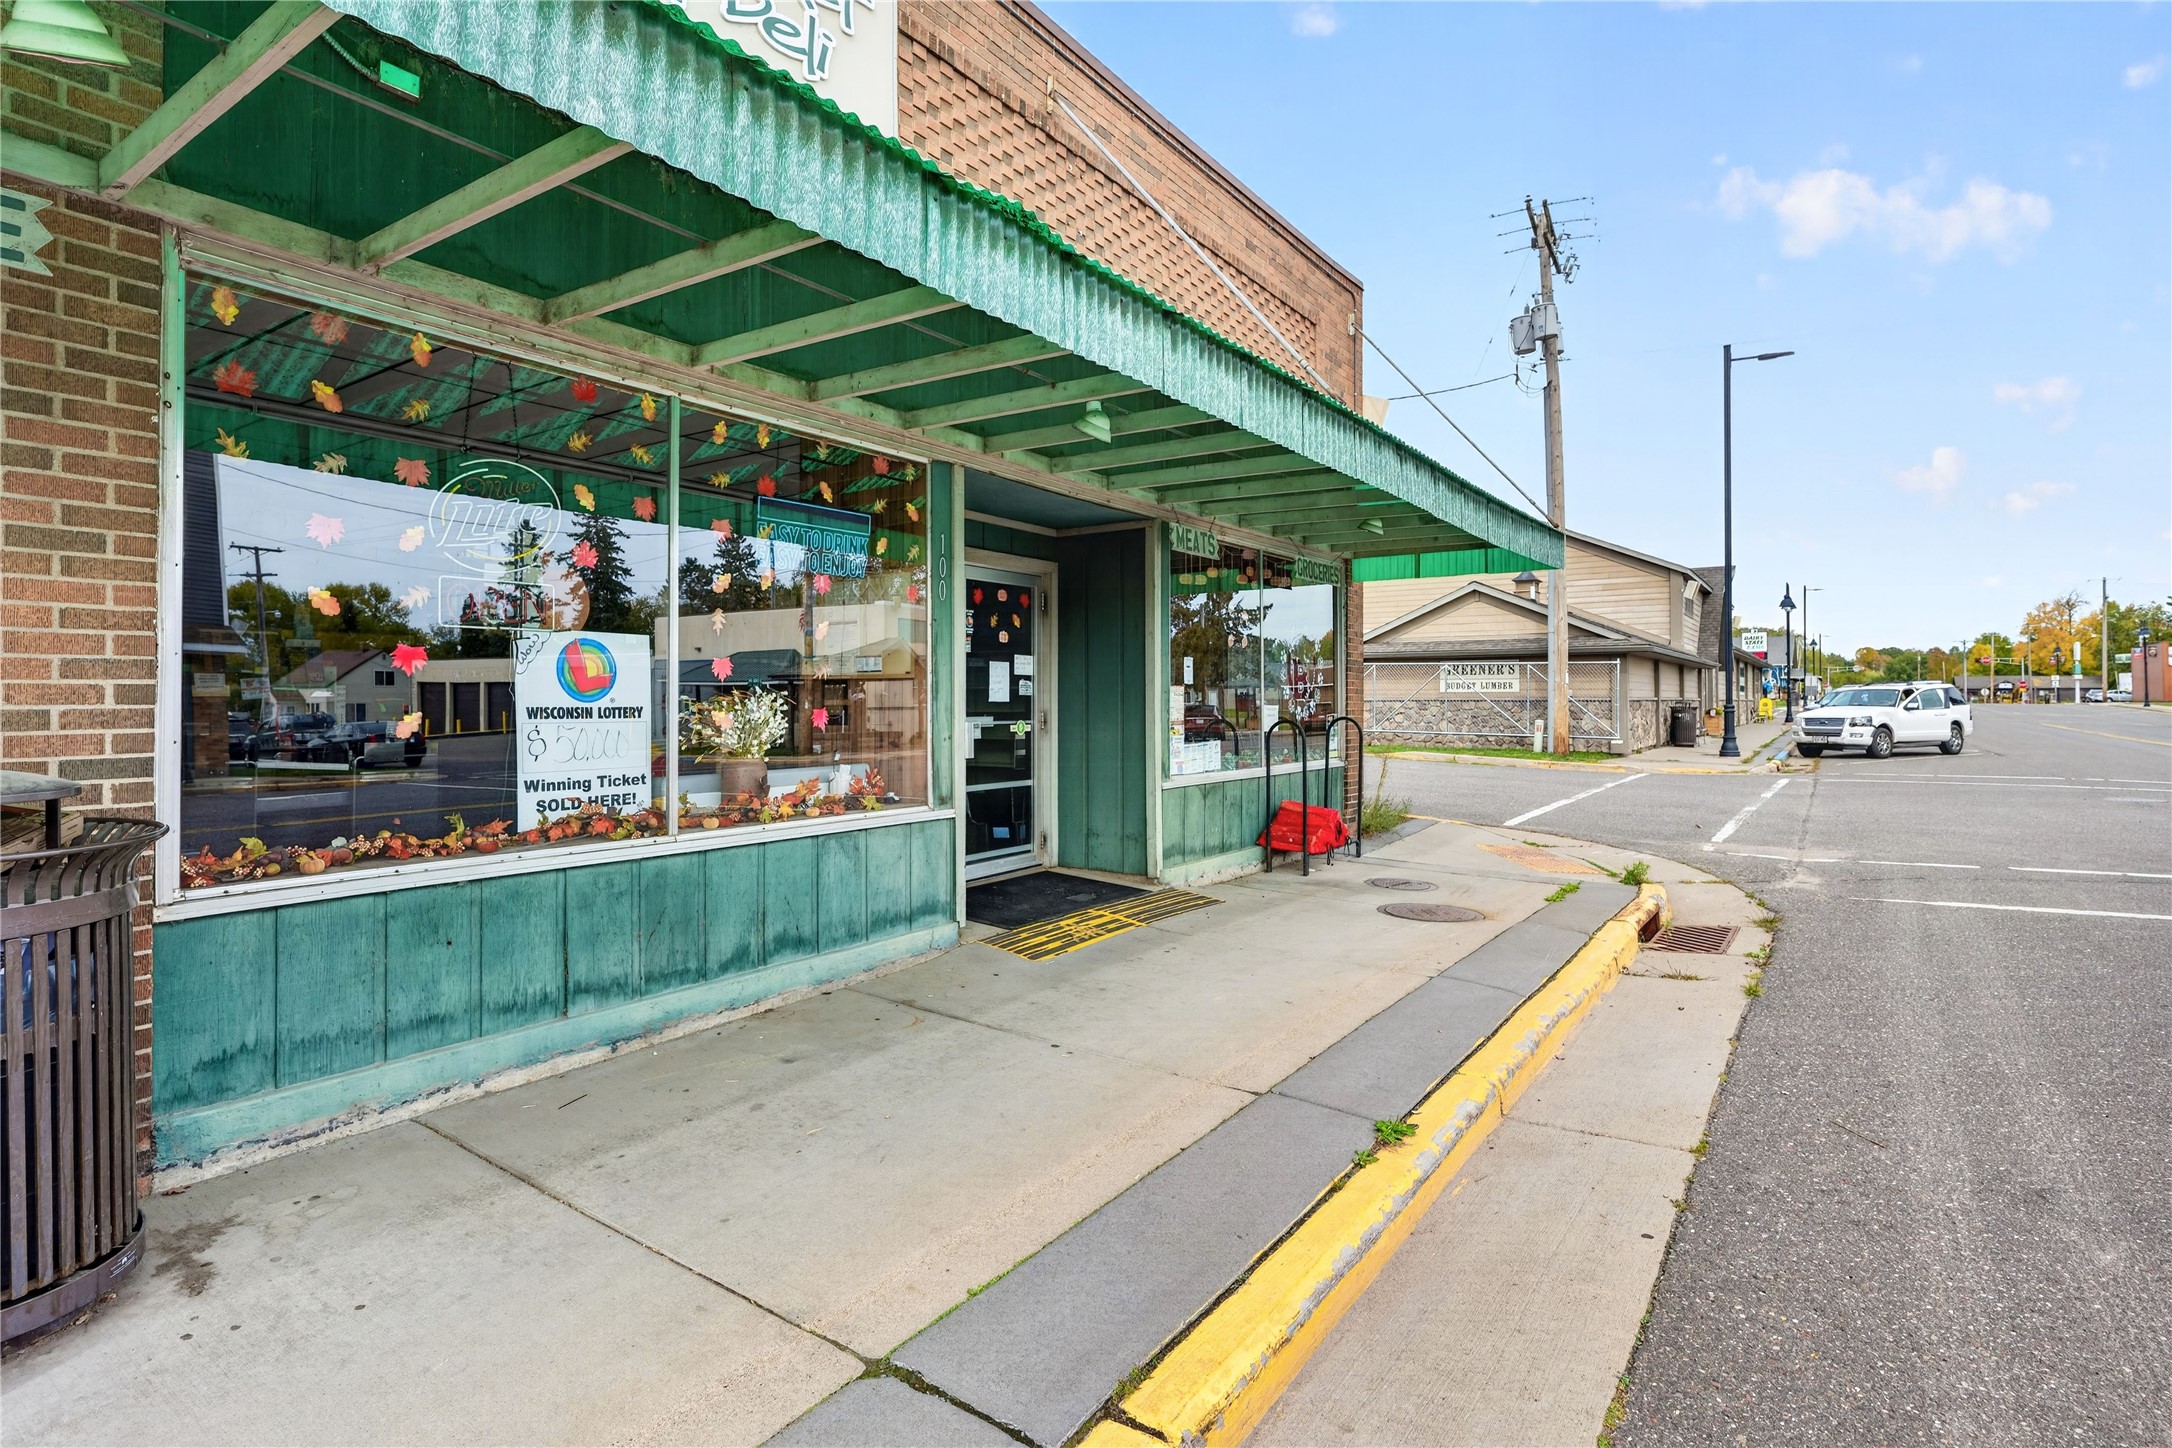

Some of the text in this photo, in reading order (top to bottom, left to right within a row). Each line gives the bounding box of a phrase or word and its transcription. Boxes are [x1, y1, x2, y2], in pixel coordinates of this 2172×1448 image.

[436, 498, 554, 547] Lite
[801, 528, 821, 551] TO
[823, 531, 869, 557] DRINK
[1176, 528, 1216, 557] MEATS
[801, 550, 820, 573] TO
[821, 553, 868, 579] ENJOY
[937, 534, 947, 601] 100
[1297, 557, 1341, 584] GROCERIES
[1480, 681, 1514, 690] LUMBER
[526, 706, 644, 720] WISCONSIN LOTTERY
[524, 772, 647, 794] Winning Ticket
[536, 797, 583, 814] SOLD
[588, 792, 637, 808] HERE!
